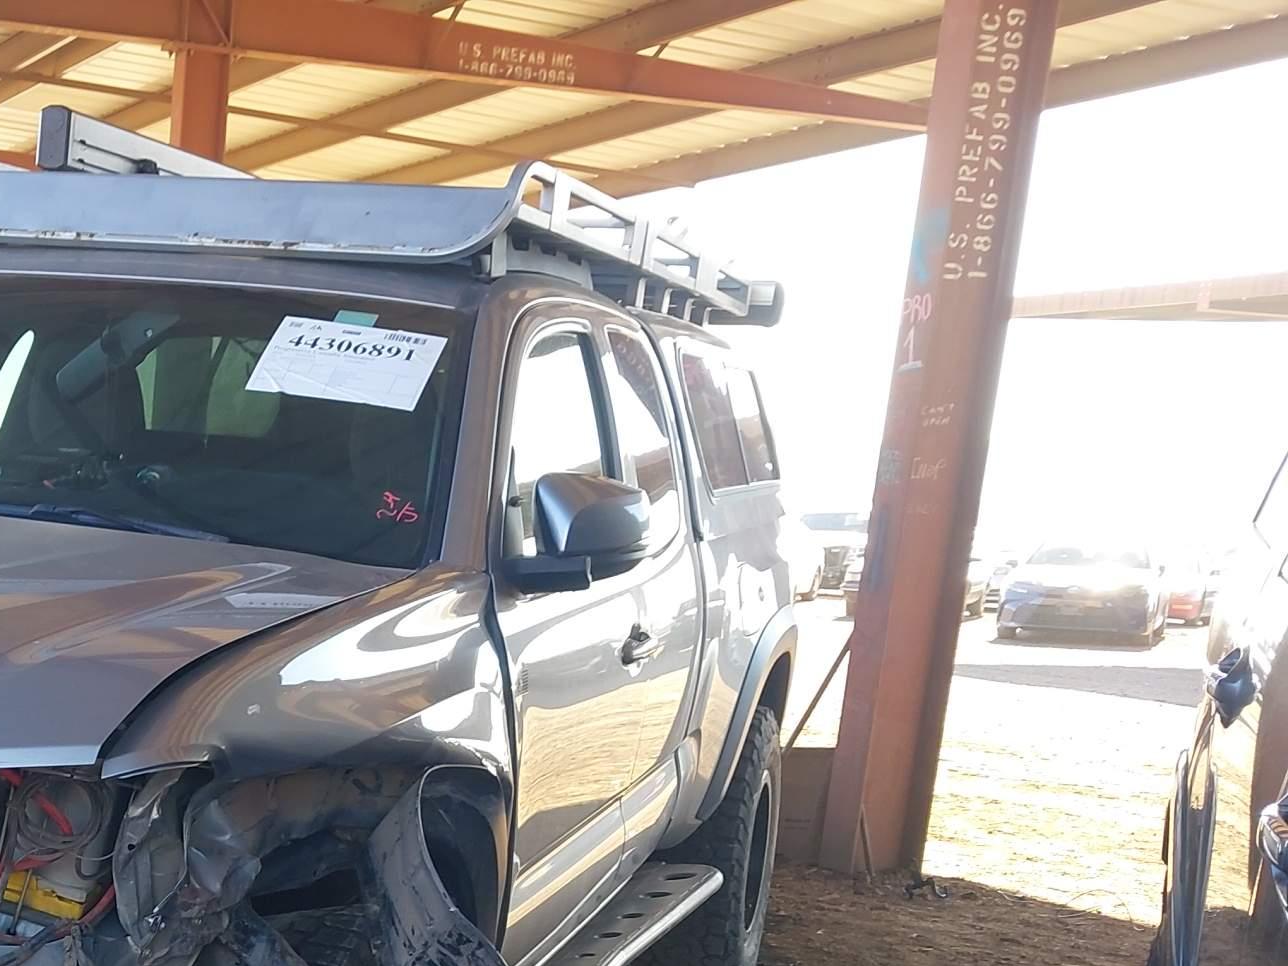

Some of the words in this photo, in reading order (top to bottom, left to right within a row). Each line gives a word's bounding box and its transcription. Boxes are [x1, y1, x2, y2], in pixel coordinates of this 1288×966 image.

[492, 45, 546, 65] PREFAB
[954, 81, 991, 203] PREFAB
[975, 3, 1004, 63] INC.
[968, 7, 1027, 279] 1-866-799-0969
[288, 333, 416, 361] 44306891
